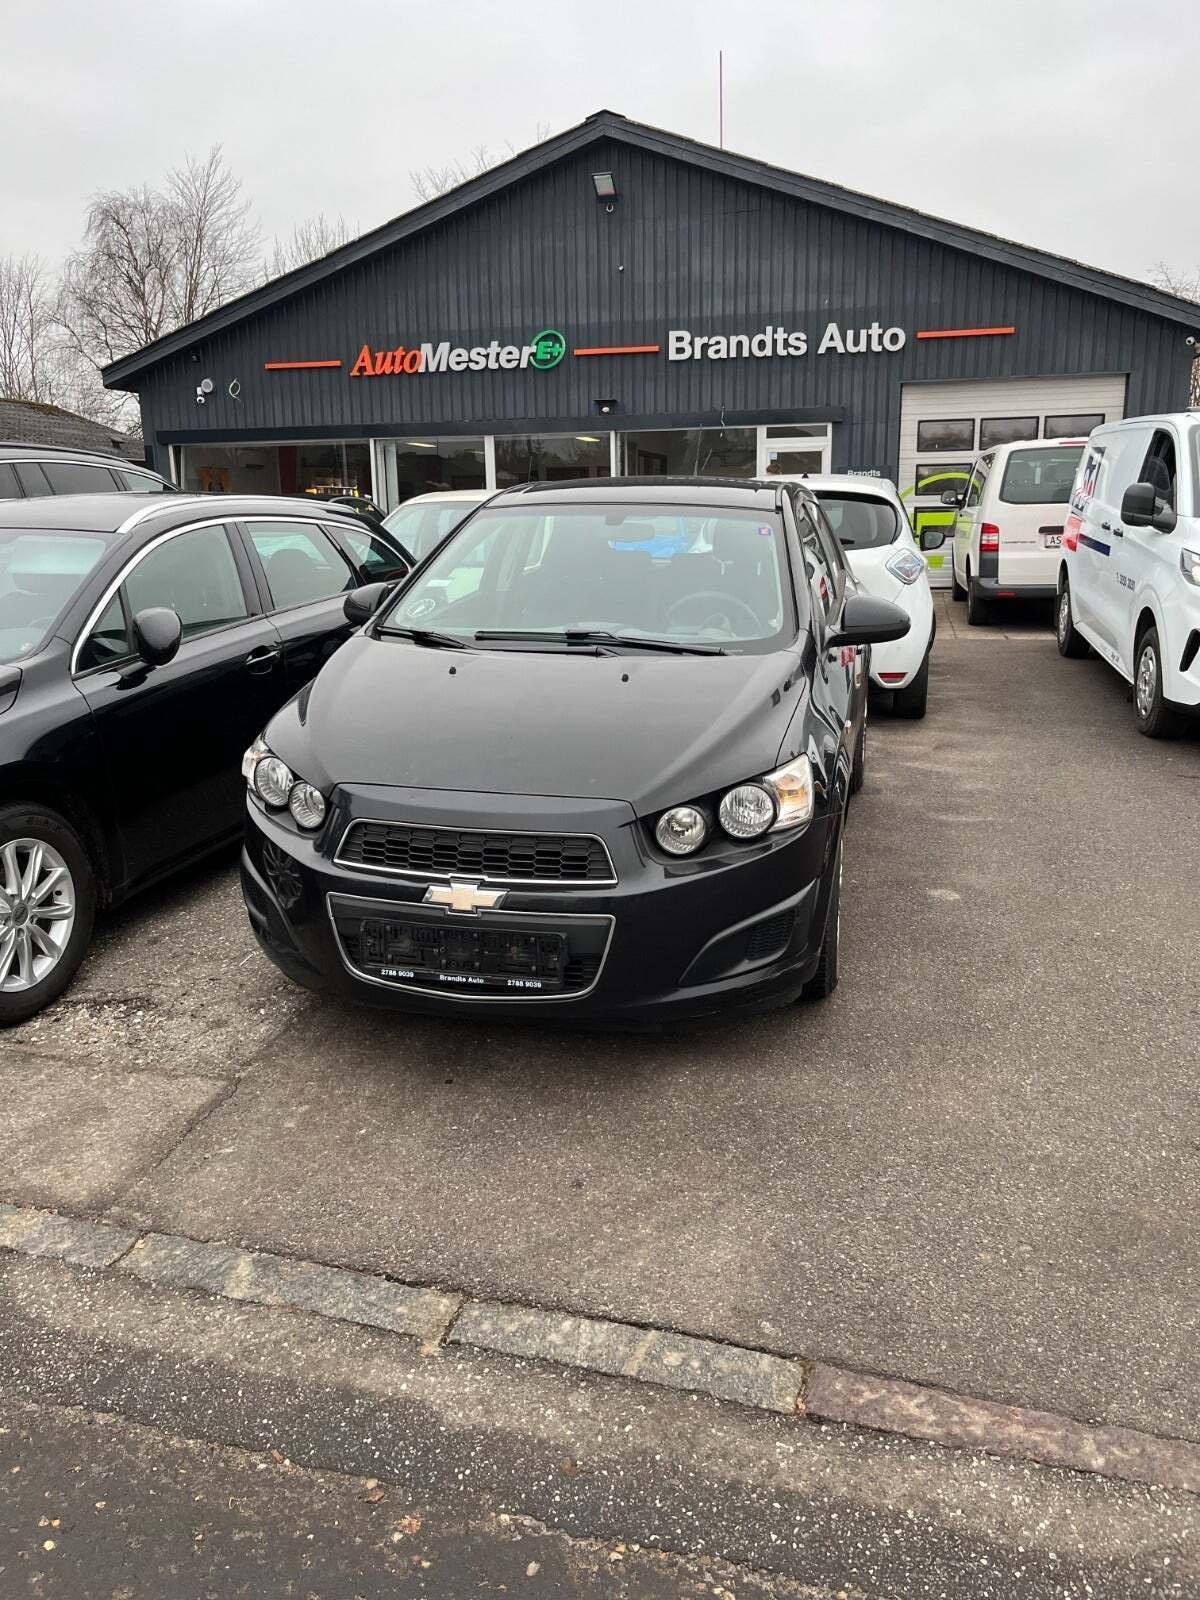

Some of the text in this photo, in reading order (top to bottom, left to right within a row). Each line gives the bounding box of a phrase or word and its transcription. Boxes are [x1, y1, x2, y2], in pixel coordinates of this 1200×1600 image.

[668, 322, 907, 361] Brandts Auto
[350, 341, 537, 376] AutoMester
[847, 469, 881, 477] Brandts
[439, 974, 467, 983] Brandts
[467, 976, 484, 984] Auto
